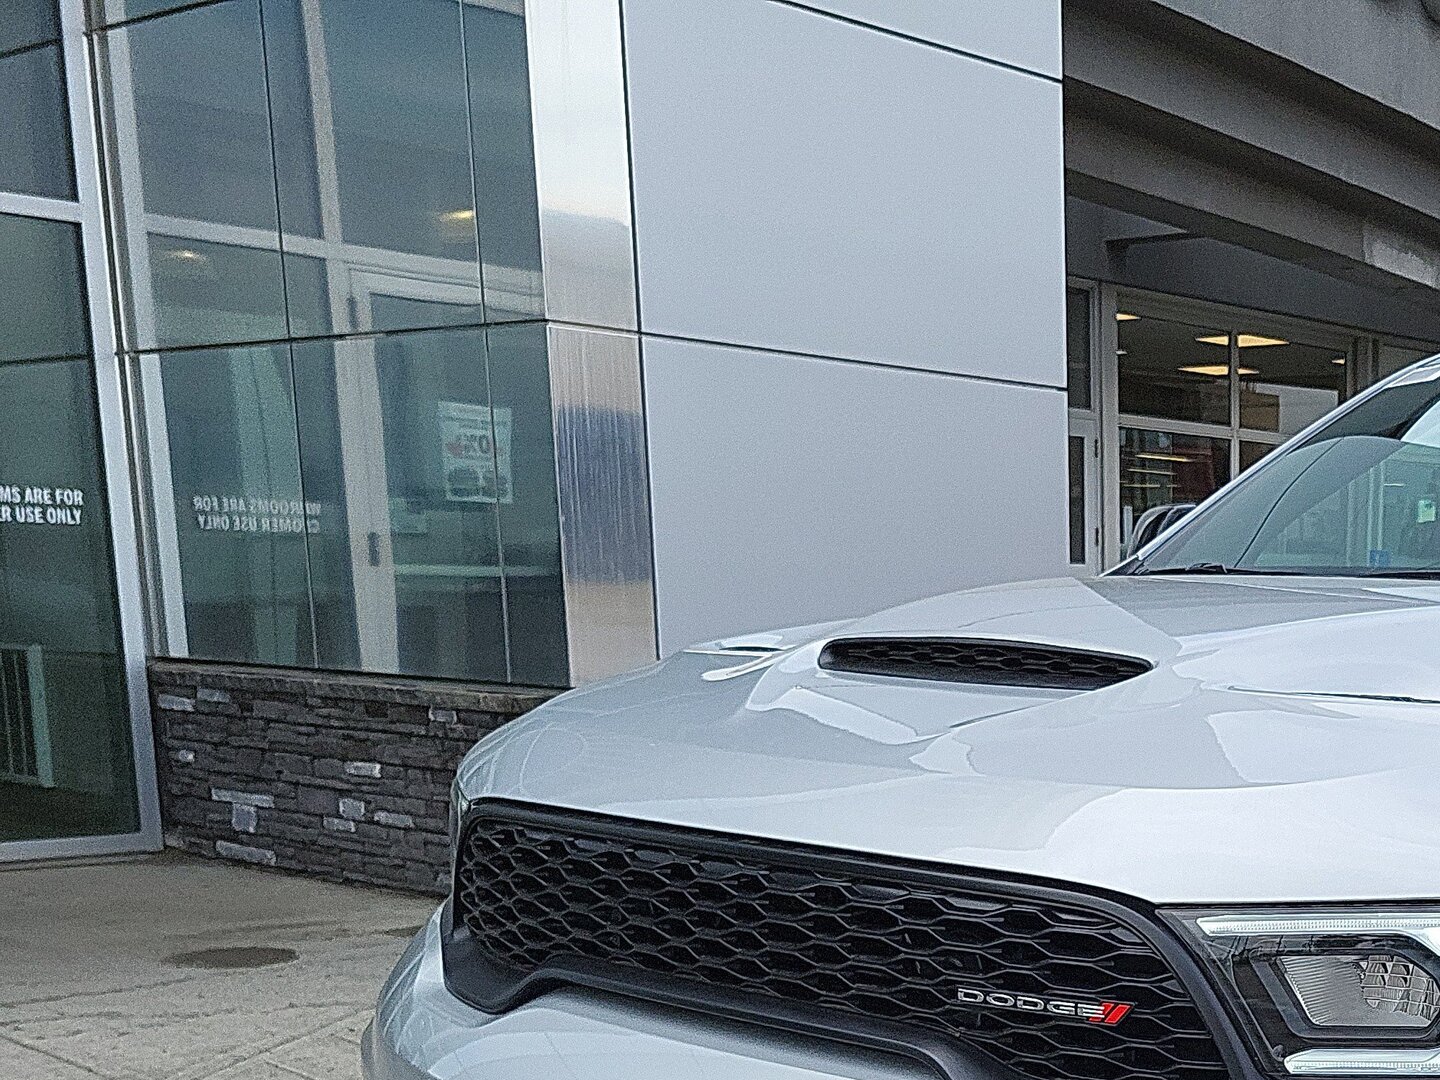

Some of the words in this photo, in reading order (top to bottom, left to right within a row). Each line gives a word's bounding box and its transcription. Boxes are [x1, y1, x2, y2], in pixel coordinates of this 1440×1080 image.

[25, 486, 53, 505] ARE
[55, 487, 84, 506] FOR
[15, 505, 45, 524] USE
[46, 506, 81, 525] ONLY
[957, 988, 1106, 1018] DODGE
